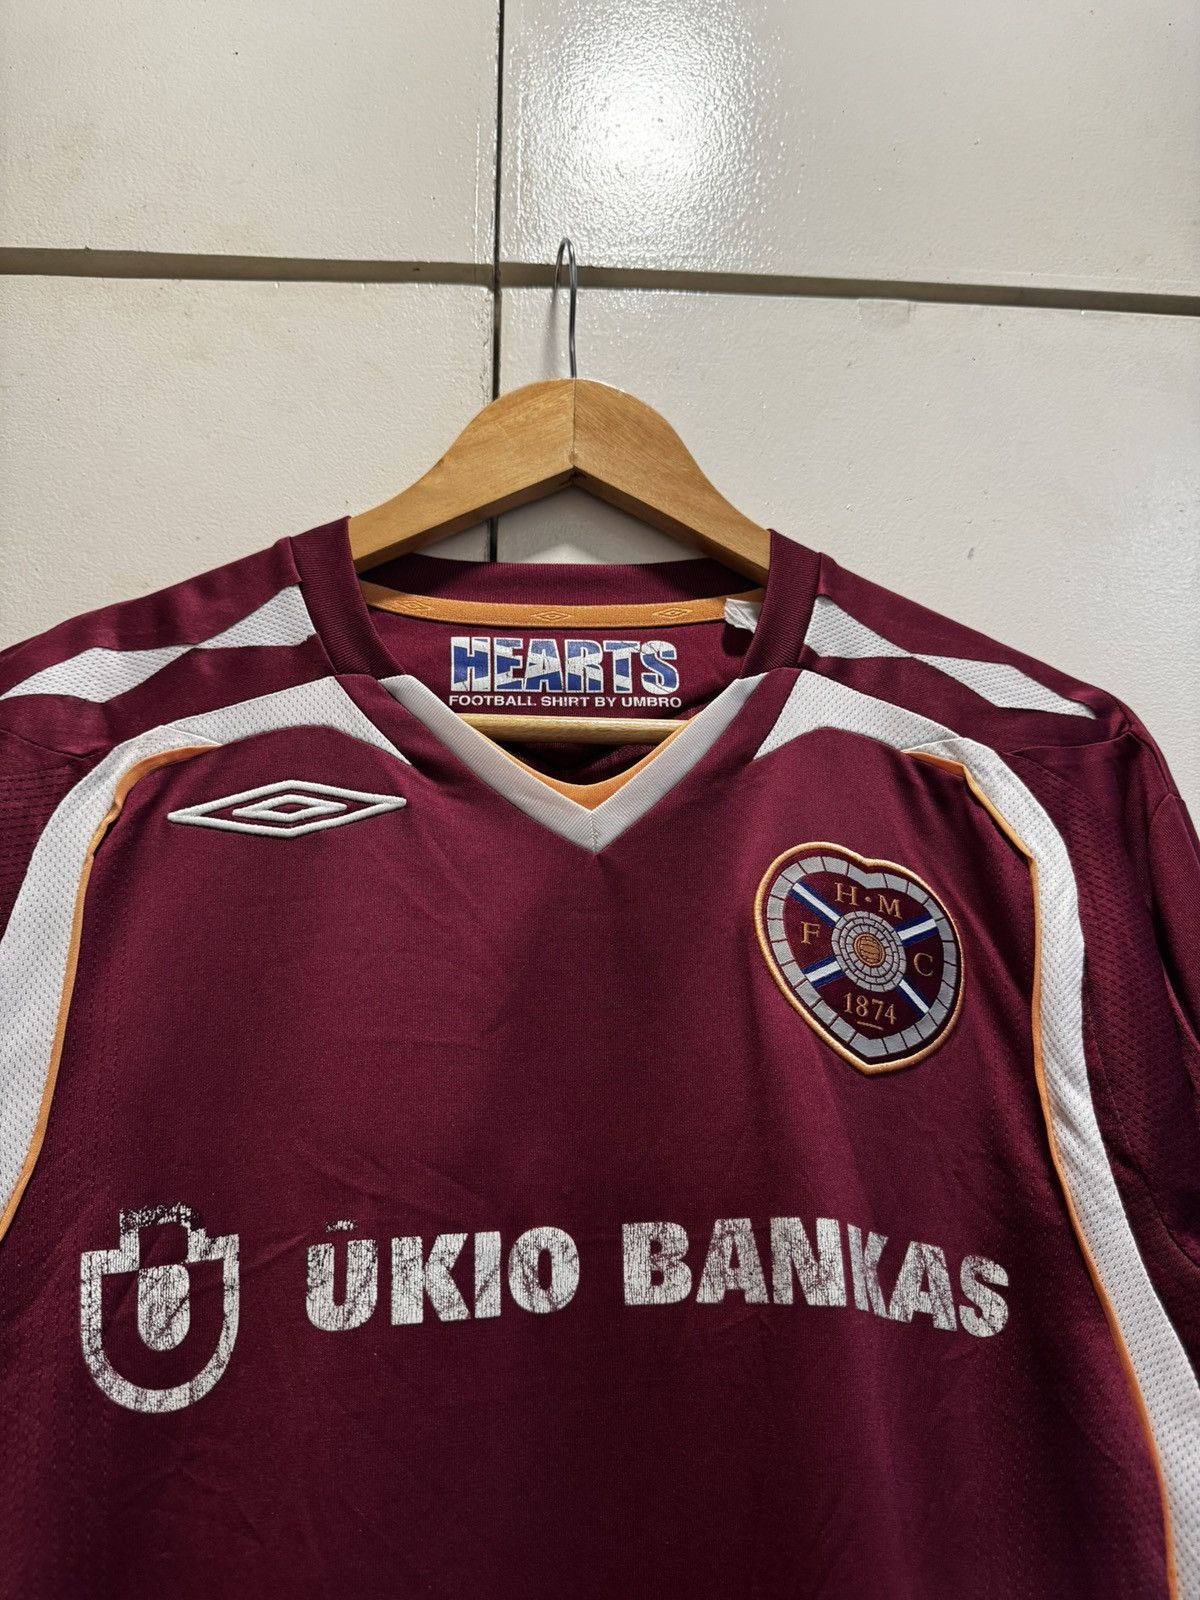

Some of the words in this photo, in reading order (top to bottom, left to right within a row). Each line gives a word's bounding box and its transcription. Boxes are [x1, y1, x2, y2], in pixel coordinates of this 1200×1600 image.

[450, 636, 680, 695] HEARTS
[449, 695, 537, 707] FOOTBALL
[541, 696, 590, 707] SHIRT
[595, 697, 616, 708] BY
[621, 698, 682, 708] UMBRO
[801, 922, 820, 944] F
[913, 952, 933, 976] C
[844, 992, 897, 1025] 1874
[622, 1217, 1009, 1338] BANKAS
